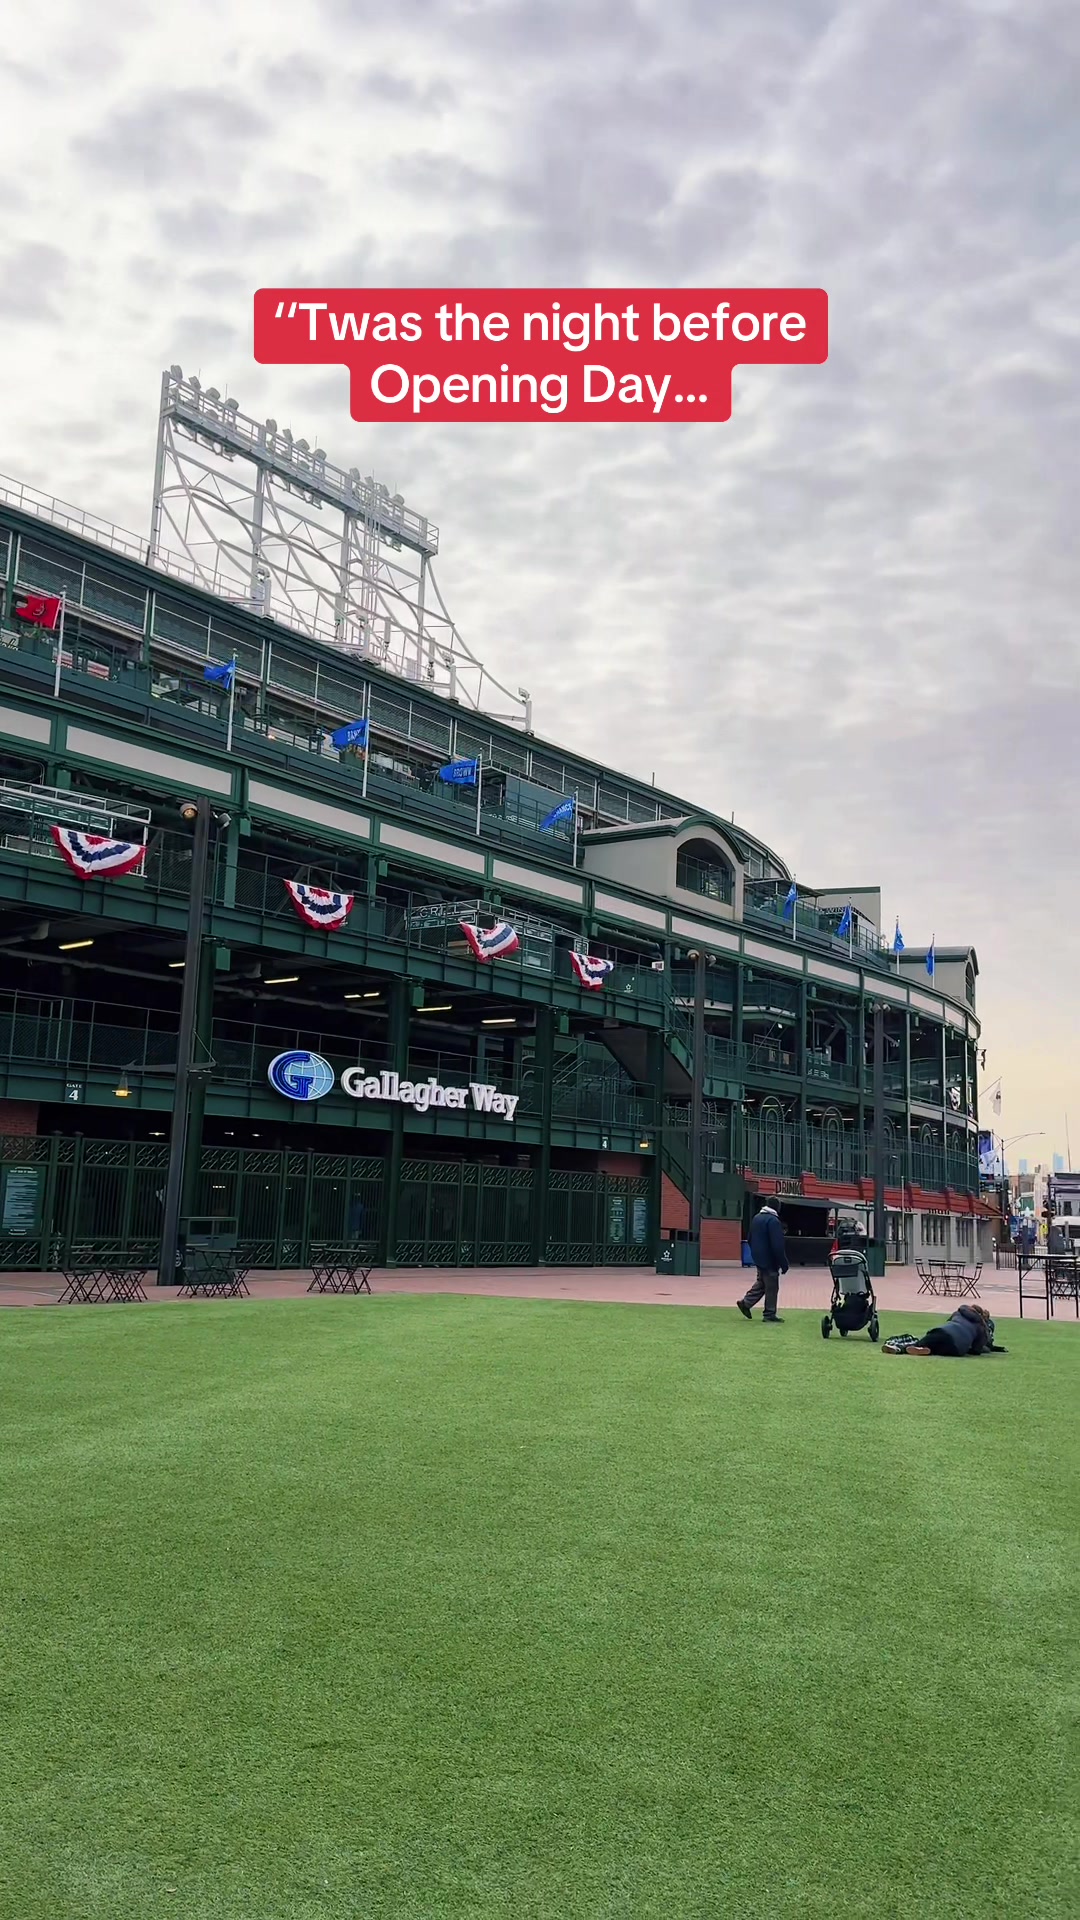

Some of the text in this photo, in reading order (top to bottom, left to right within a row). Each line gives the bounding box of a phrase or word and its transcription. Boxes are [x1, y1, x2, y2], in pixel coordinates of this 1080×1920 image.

[68, 1089, 79, 1101] 4
[340, 1066, 520, 1121] Gallagher Way
[602, 1140, 608, 1149] 4
